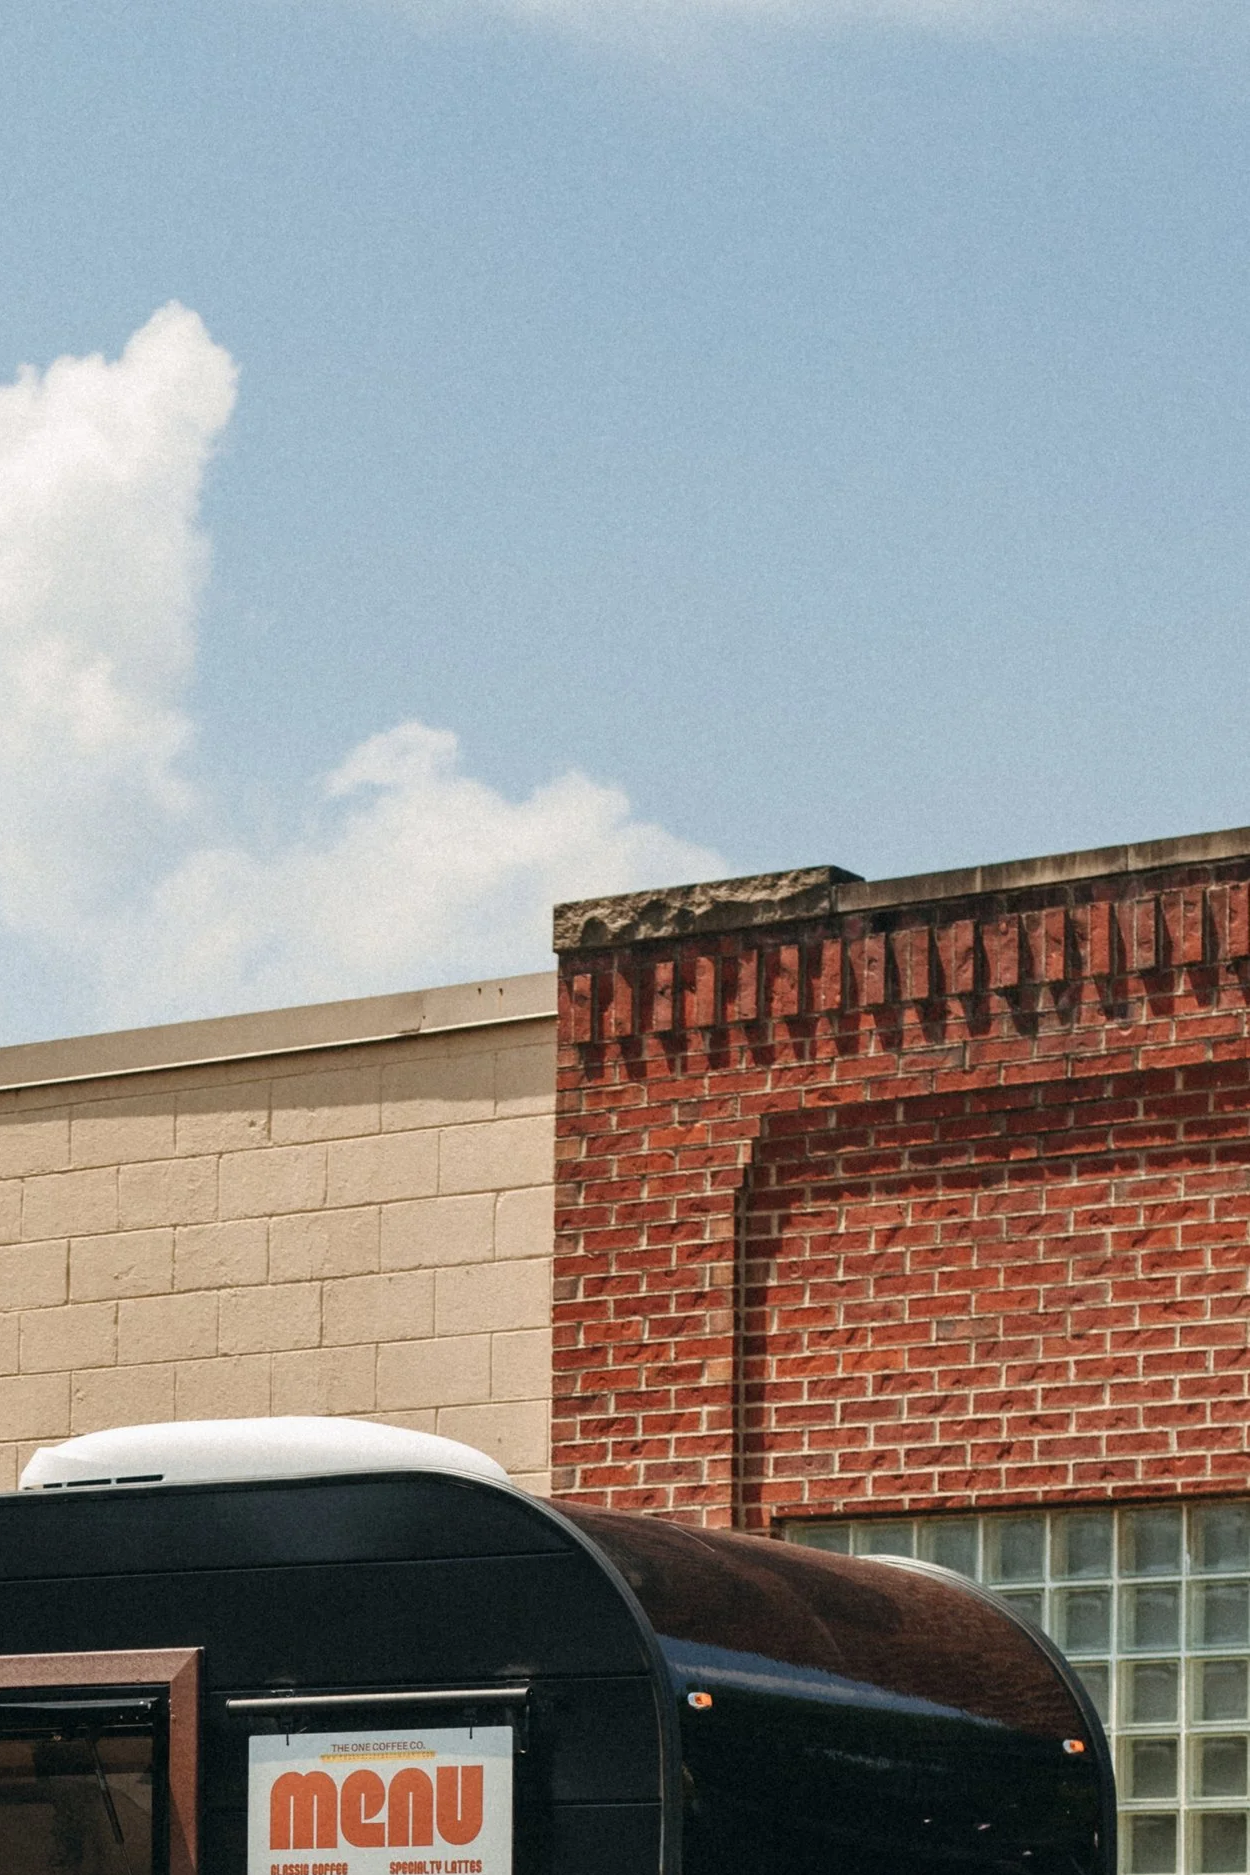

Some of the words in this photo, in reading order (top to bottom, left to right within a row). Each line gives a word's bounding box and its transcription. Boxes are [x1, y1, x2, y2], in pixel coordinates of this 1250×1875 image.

[332, 1743, 350, 1753] THE
[351, 1742, 370, 1752] ONE
[372, 1741, 408, 1752] COFFEE
[410, 1740, 426, 1750] CO.
[389, 1860, 442, 1875] SPECIALTY
[444, 1859, 483, 1874] LATTES
